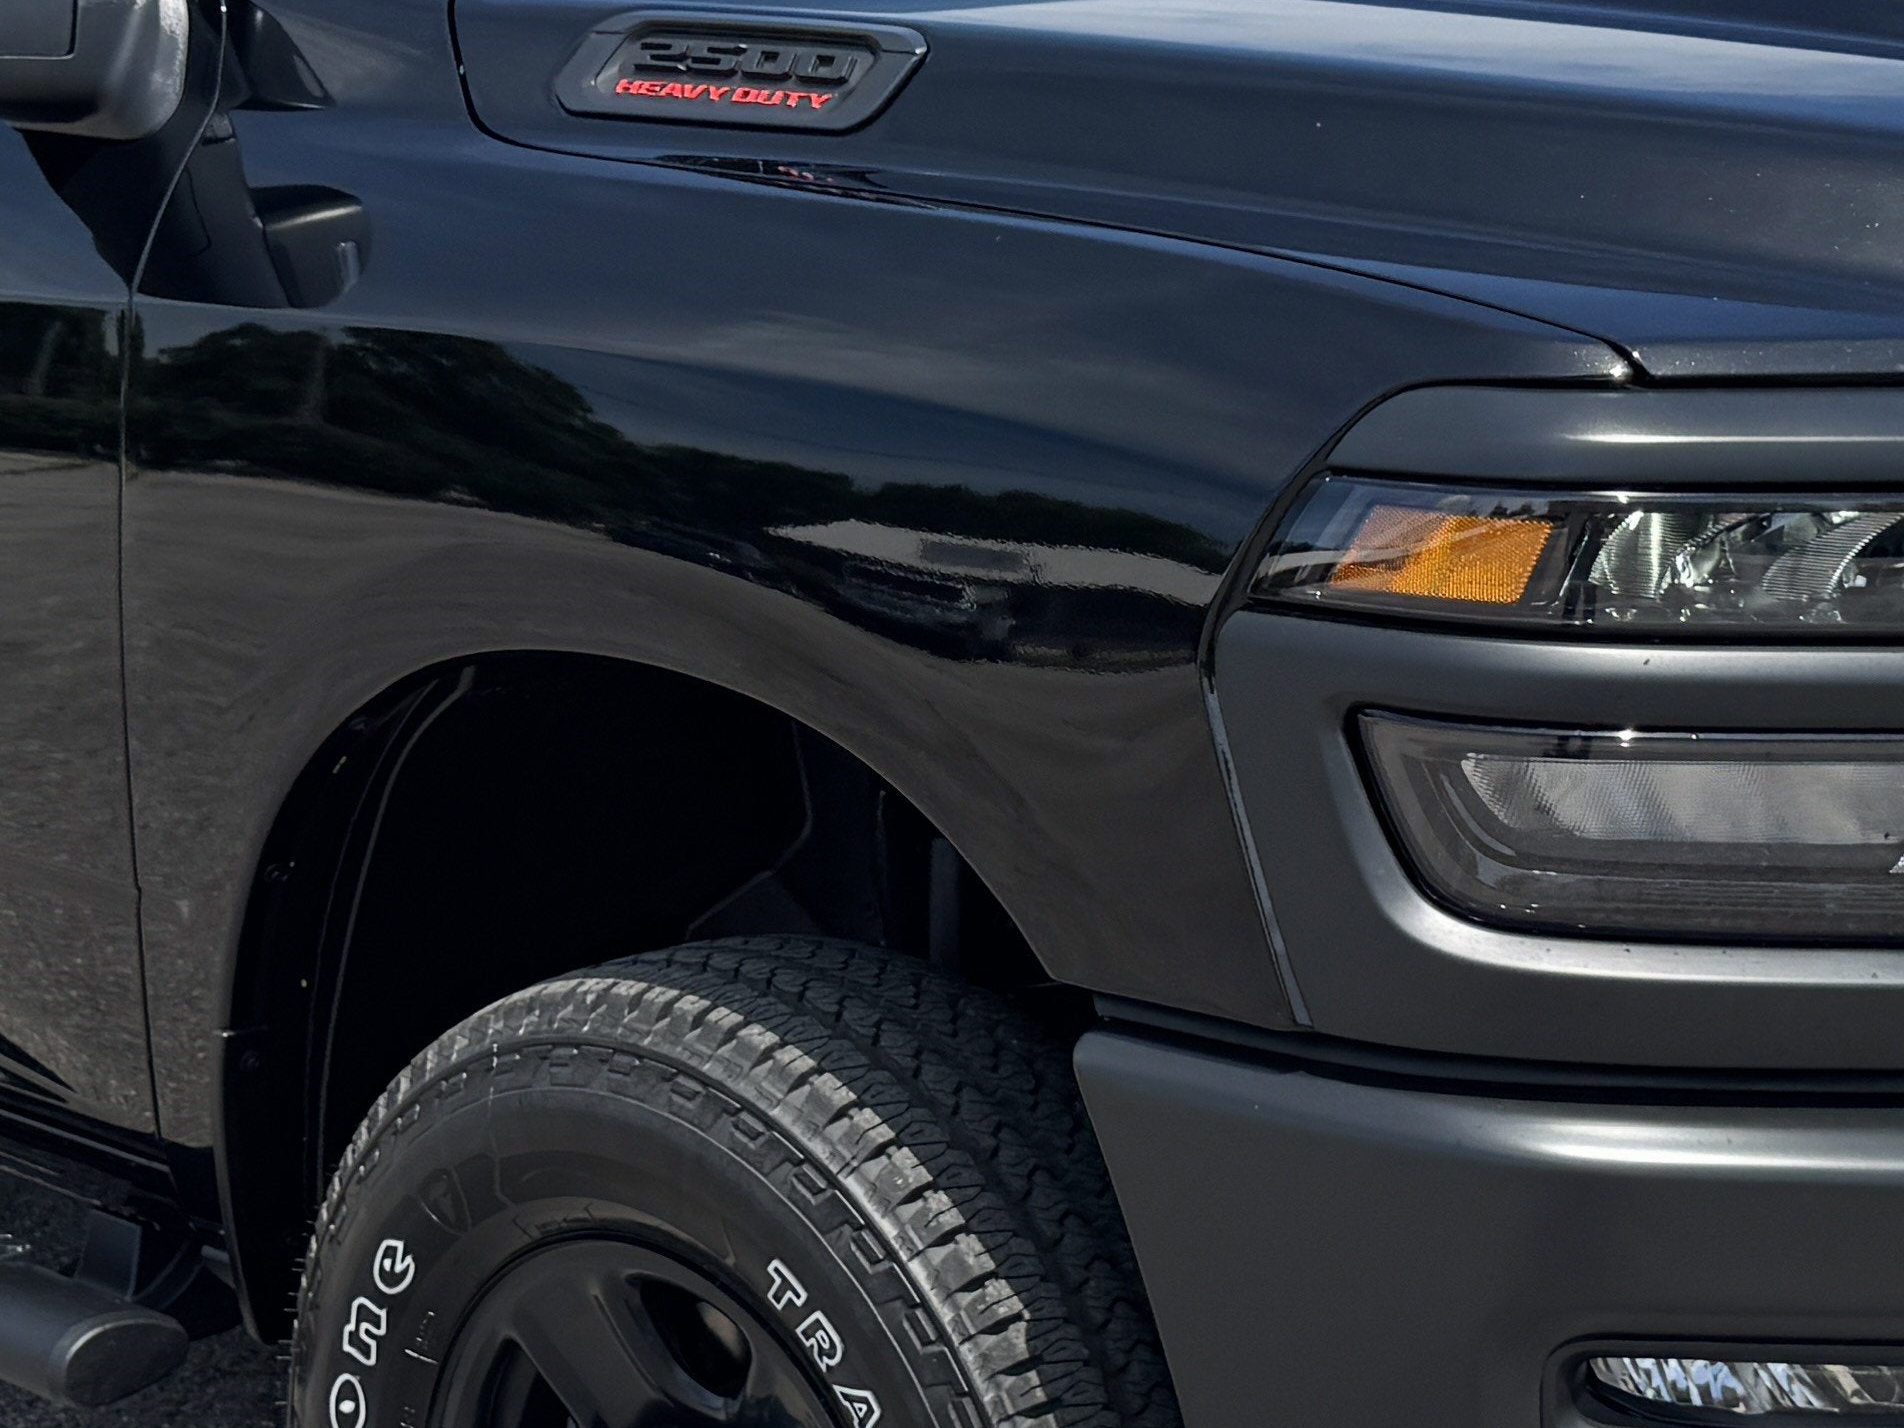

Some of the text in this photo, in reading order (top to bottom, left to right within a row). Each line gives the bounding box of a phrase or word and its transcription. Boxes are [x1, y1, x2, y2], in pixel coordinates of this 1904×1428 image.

[632, 40, 859, 87] 2500
[615, 78, 836, 109] HEAVY DUTY
